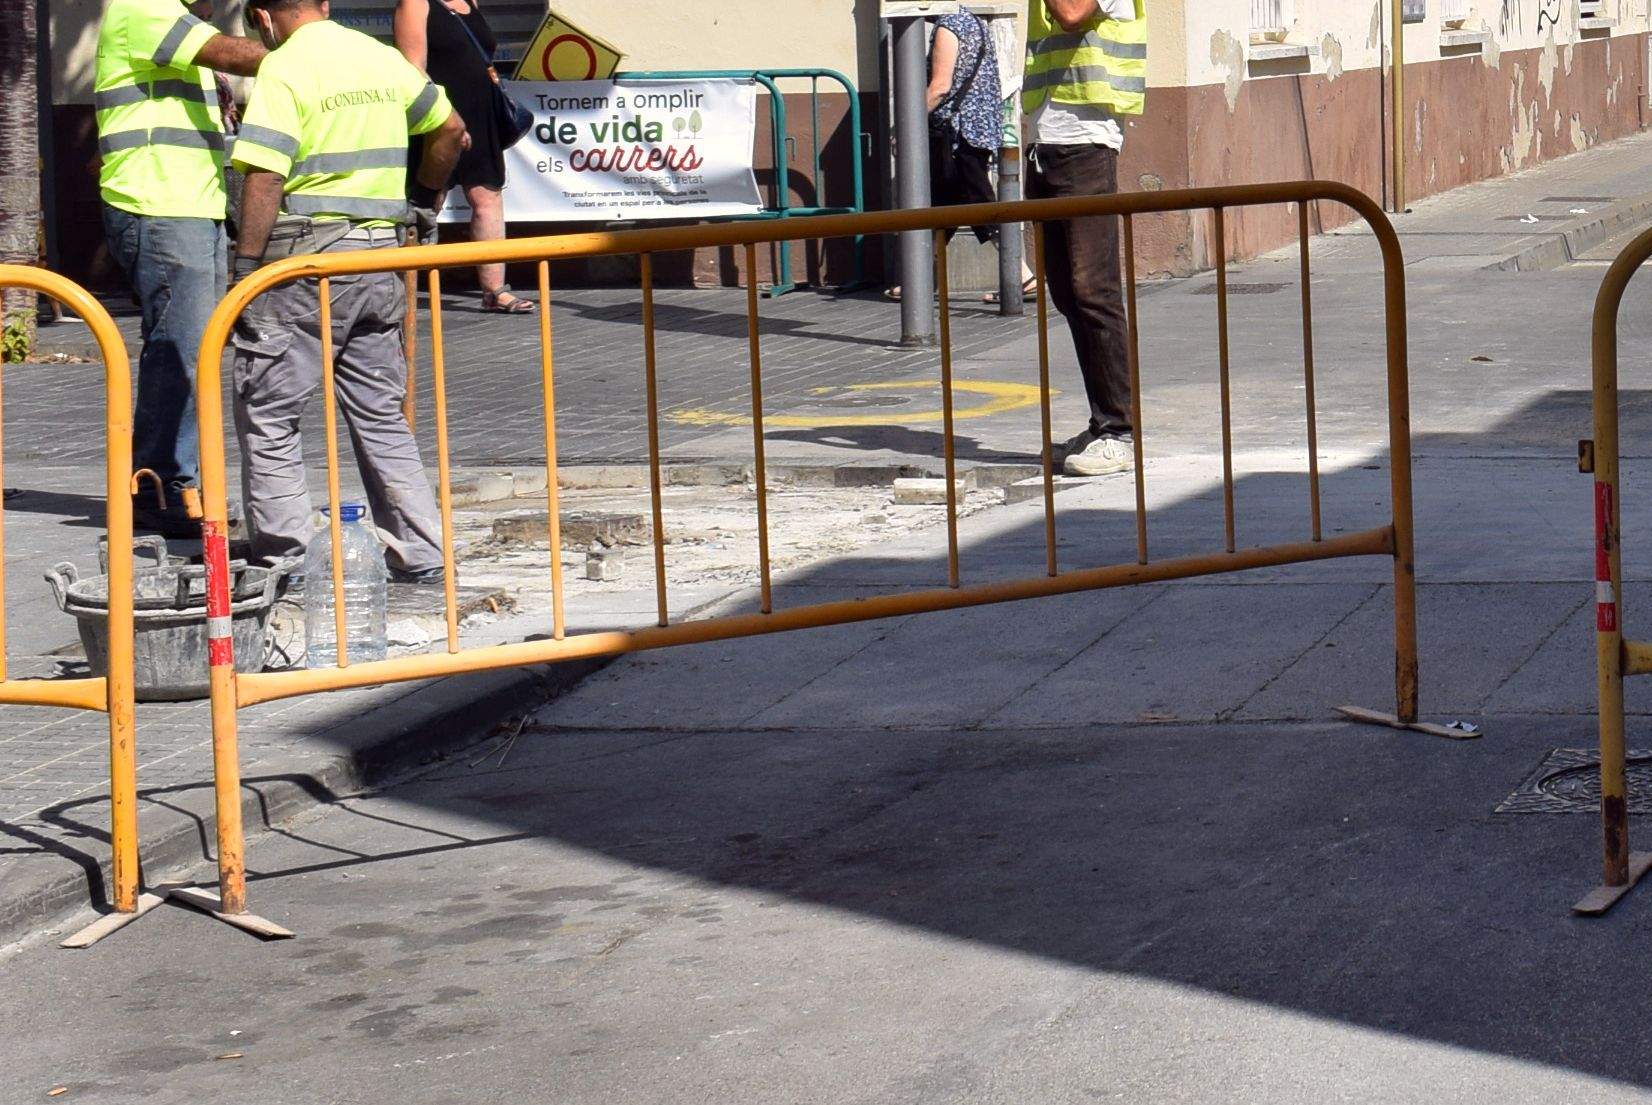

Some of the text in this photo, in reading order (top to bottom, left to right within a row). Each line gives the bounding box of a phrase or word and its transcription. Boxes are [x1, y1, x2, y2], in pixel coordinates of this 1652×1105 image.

[536, 90, 704, 112] Tornem a omplir
[535, 114, 663, 145] de vida
[536, 145, 704, 173] els carrers
[623, 175, 704, 187] amb seguretat
[562, 190, 623, 198] Transformarem
[574, 200, 596, 208] ciutat
[620, 199, 641, 208] espai
[642, 199, 654, 207] per
